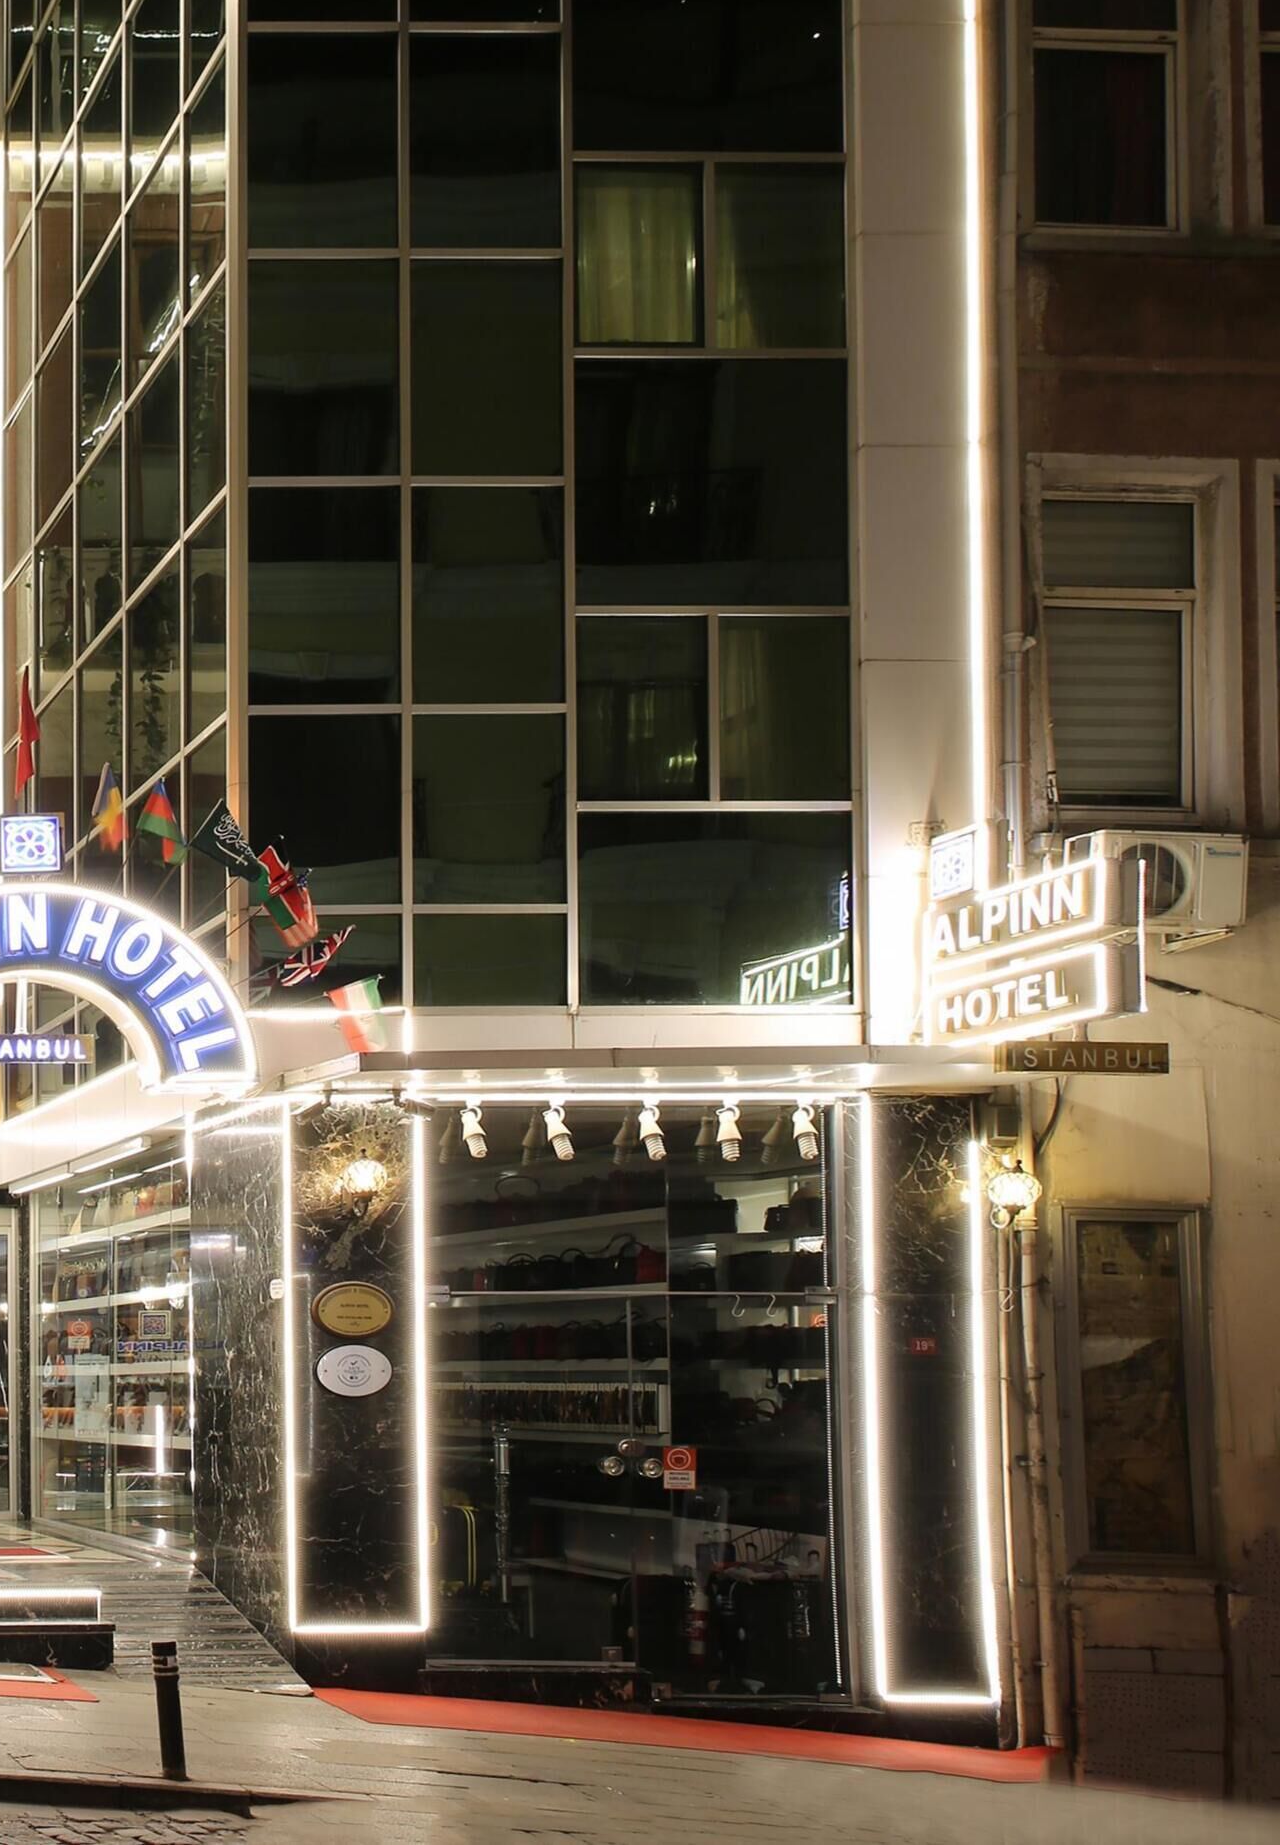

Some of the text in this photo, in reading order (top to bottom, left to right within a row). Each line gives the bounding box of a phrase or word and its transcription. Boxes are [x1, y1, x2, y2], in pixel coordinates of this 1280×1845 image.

[932, 871, 1084, 955] ALPINN
[66, 898, 238, 1073] HOTEL
[938, 970, 1070, 1034] HOTEL
